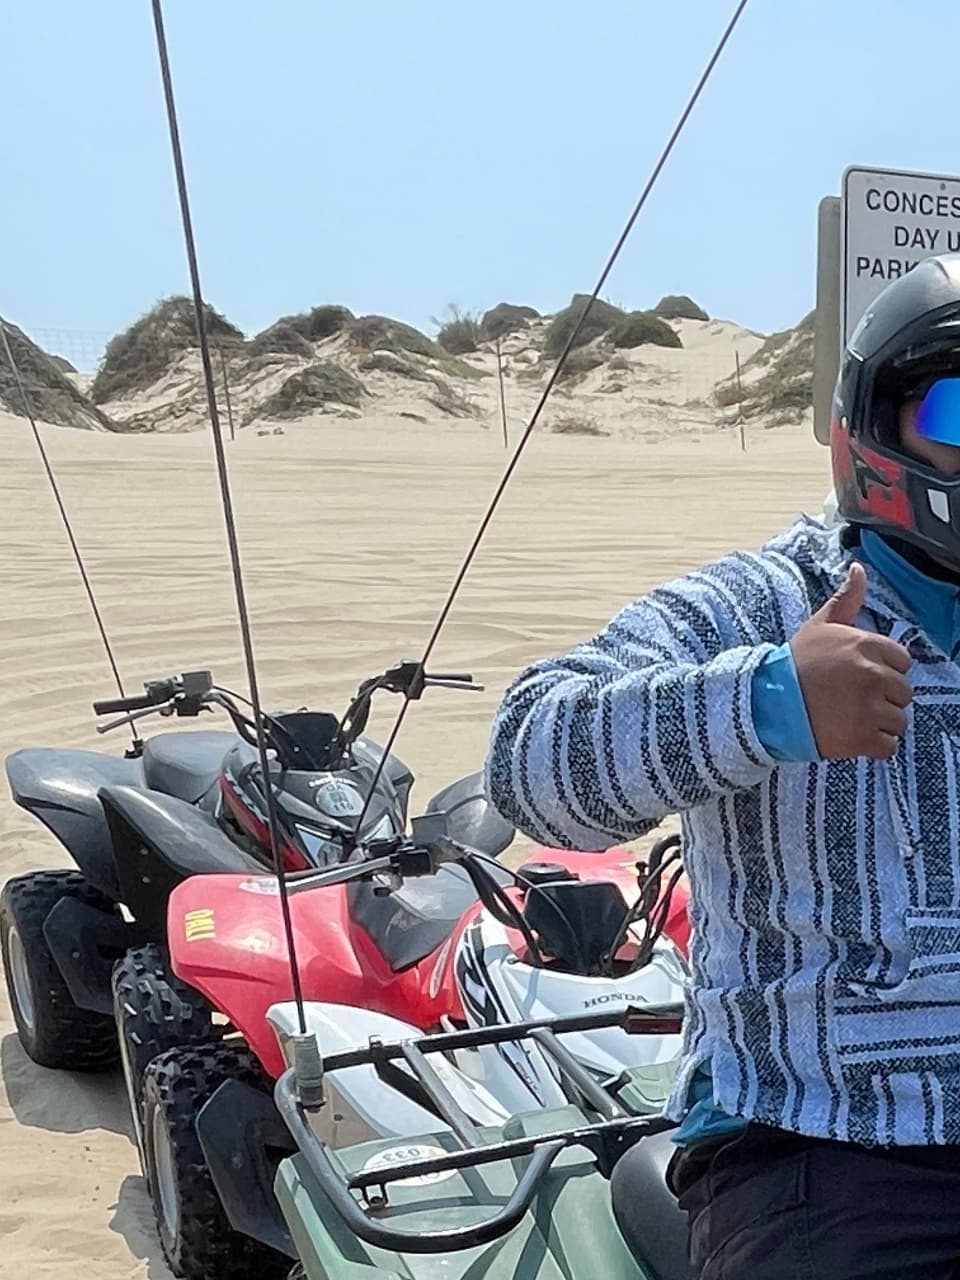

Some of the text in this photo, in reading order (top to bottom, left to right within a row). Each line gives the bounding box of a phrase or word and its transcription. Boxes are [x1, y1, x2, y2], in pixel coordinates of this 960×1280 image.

[894, 226, 940, 250] DAY
[857, 256, 919, 279] PARK
[583, 993, 649, 1008] HONDA
